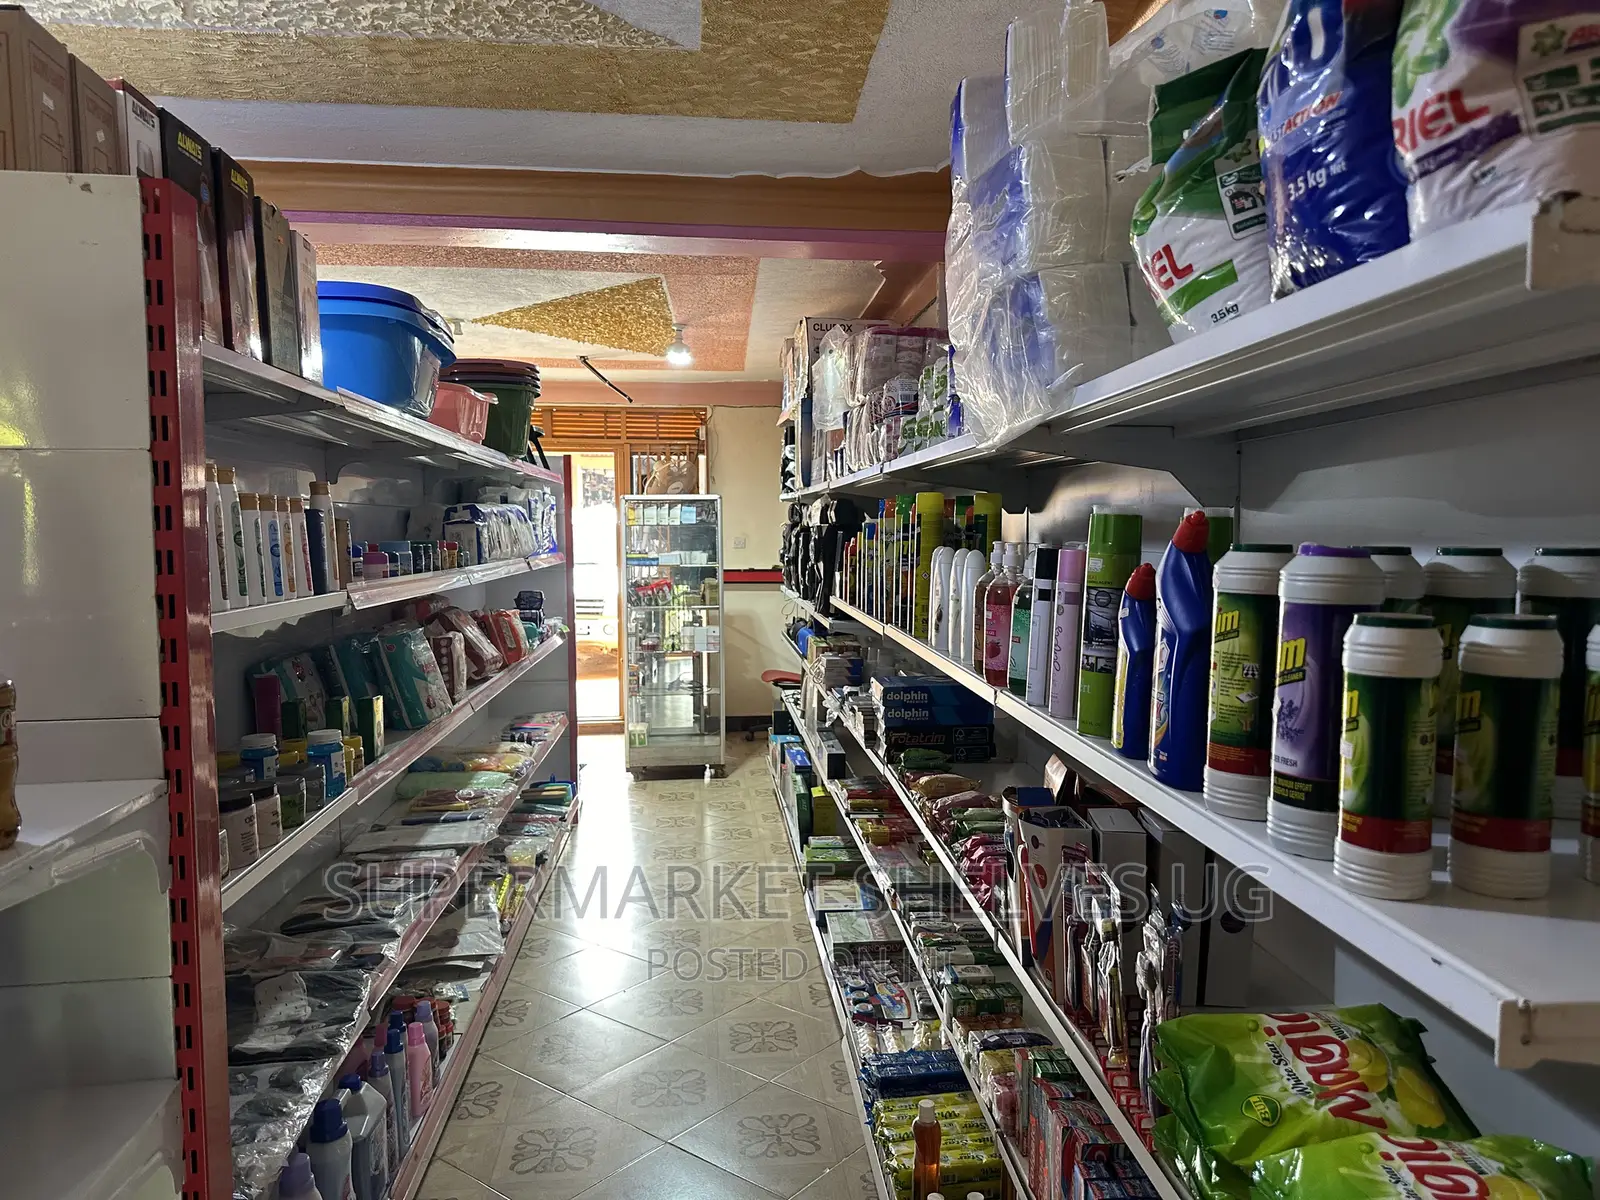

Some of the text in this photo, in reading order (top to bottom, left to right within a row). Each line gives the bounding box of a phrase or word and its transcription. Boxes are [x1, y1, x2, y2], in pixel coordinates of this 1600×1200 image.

[1392, 89, 1490, 153] RIEL
[1288, 176, 1306, 201] 3.5
[1306, 167, 1328, 189] kg
[813, 322, 853, 333] CLUOX
[1216, 607, 1240, 634] im
[886, 690, 928, 702] dolphin
[887, 707, 929, 719] dolphin
[1264, 1041, 1315, 1098] White Star
[1379, 1132, 1491, 1200] gic
